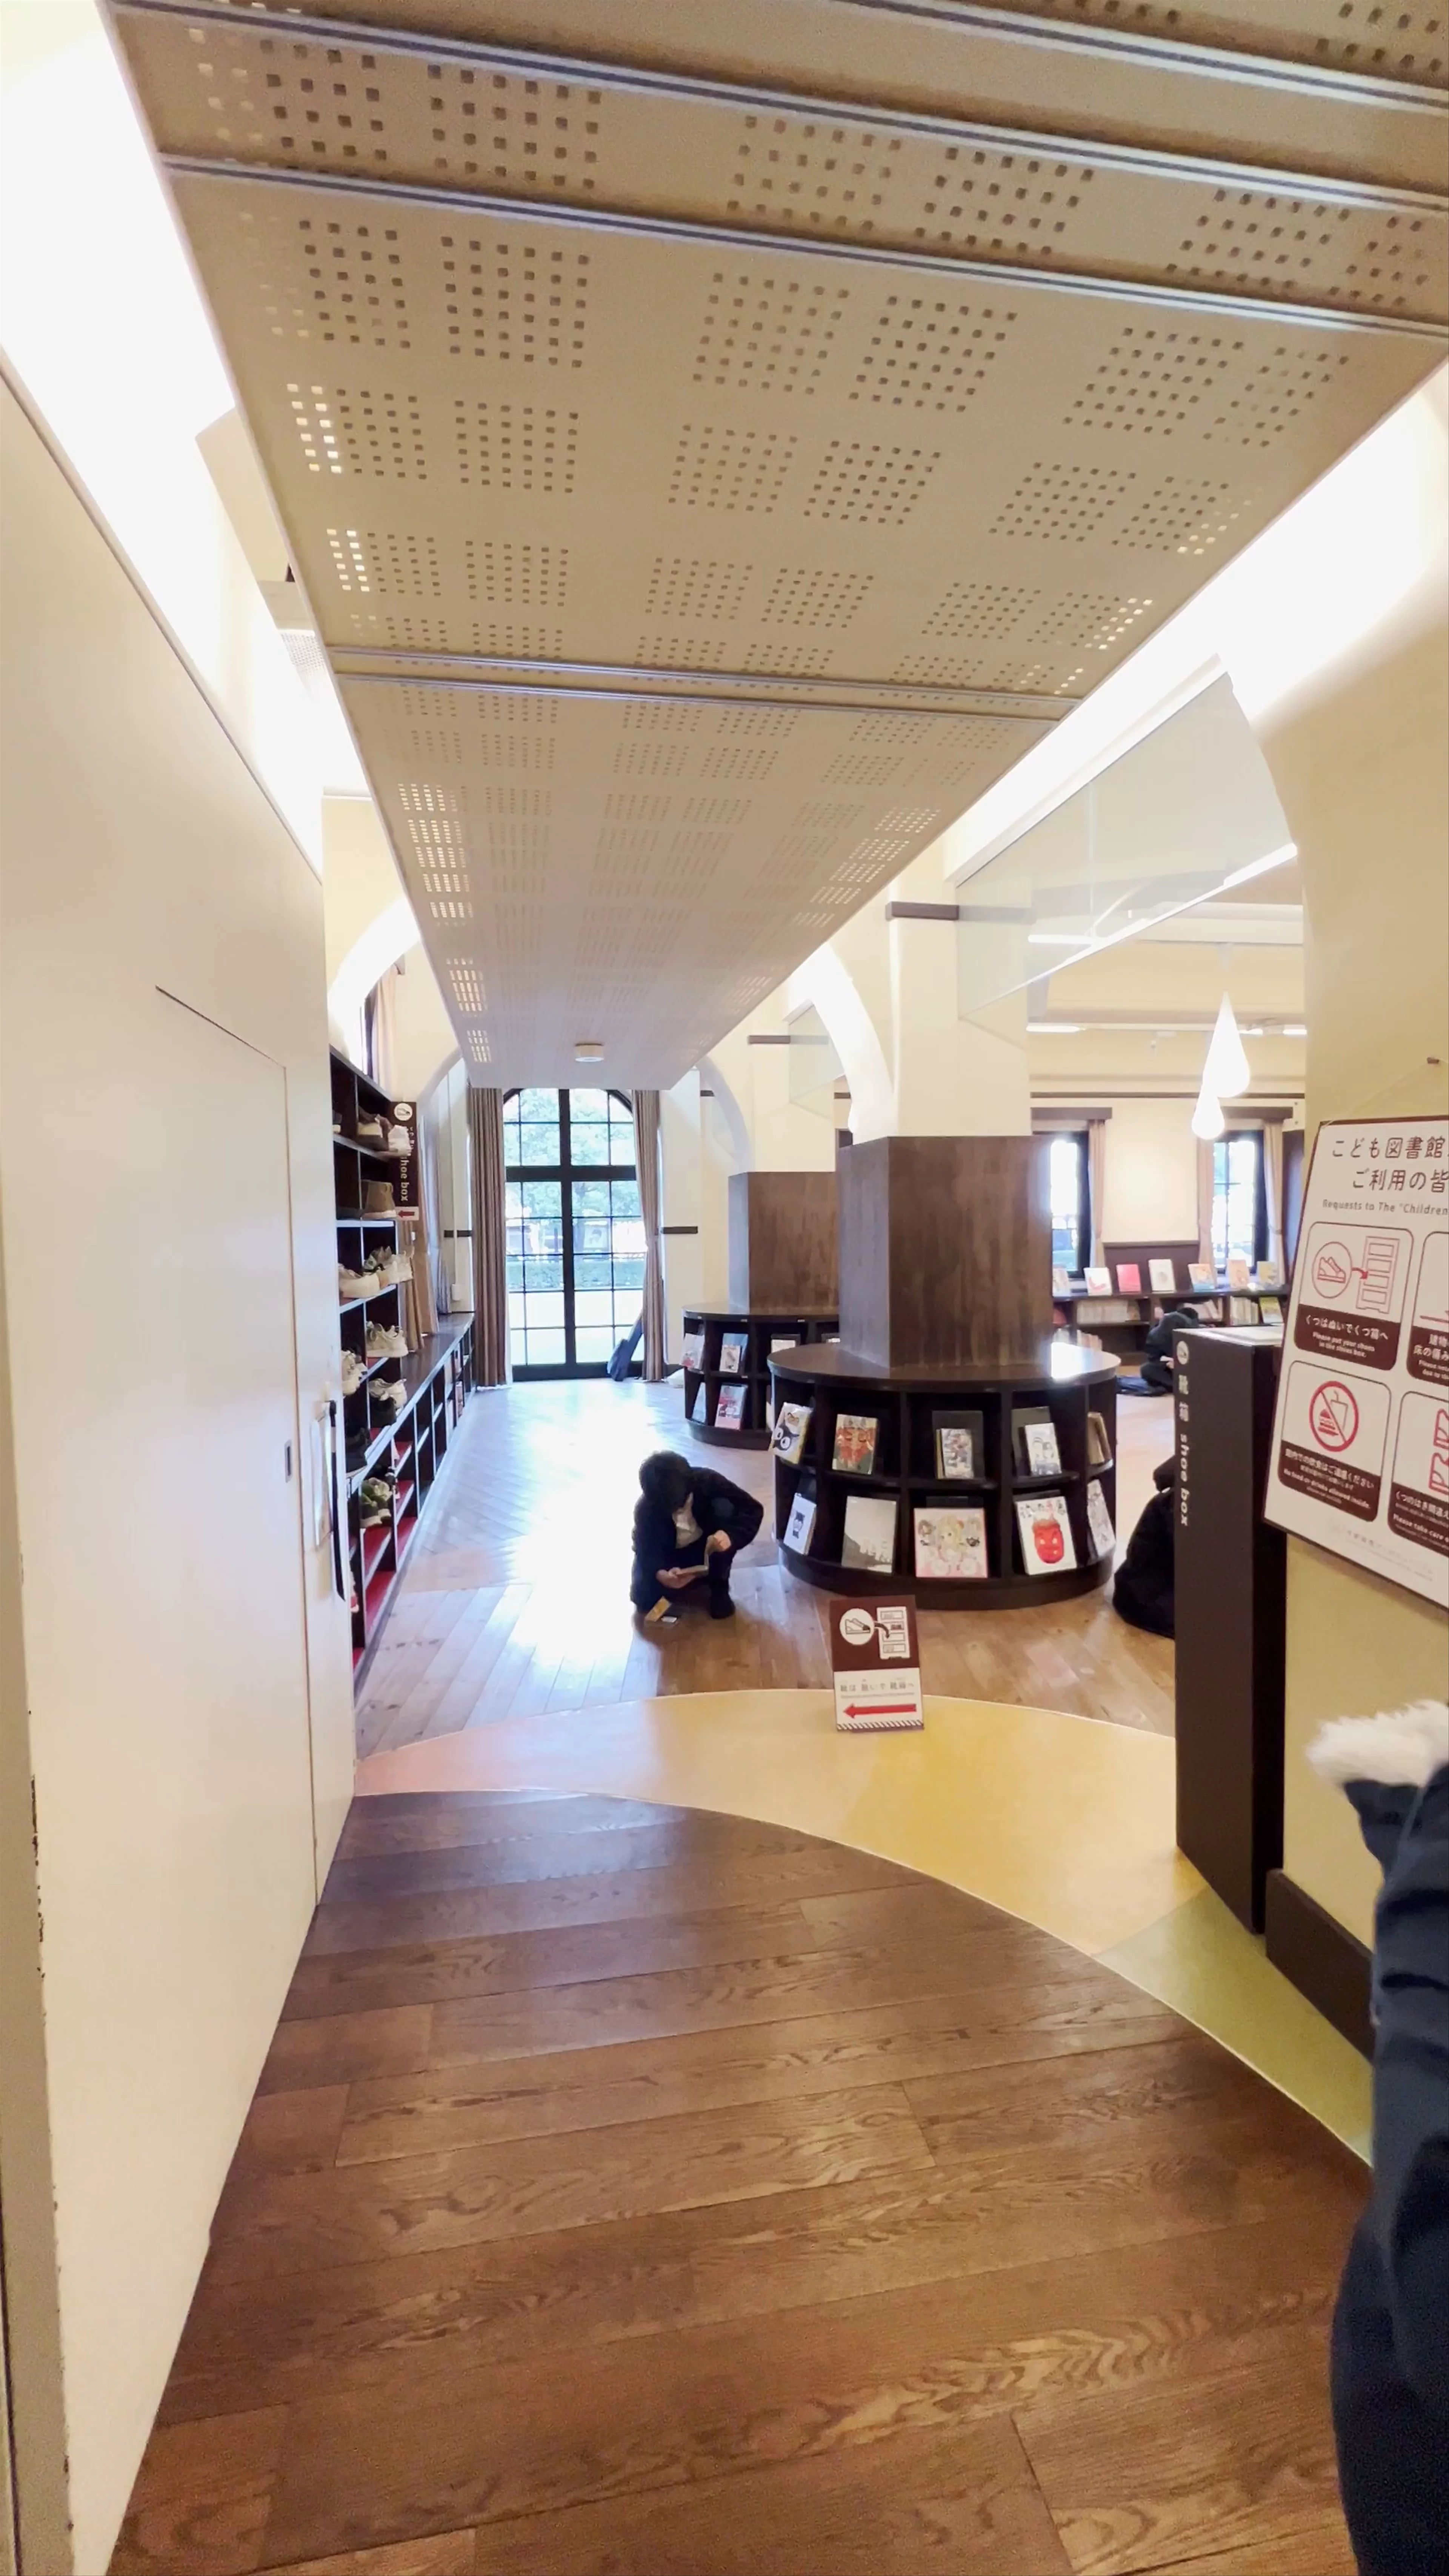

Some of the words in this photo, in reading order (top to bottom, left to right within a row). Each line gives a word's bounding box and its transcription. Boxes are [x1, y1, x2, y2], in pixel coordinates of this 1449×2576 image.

[1332, 1136, 1449, 1159] こども図書館
[400, 1155, 409, 1179] hoe
[400, 1182, 410, 1201] box
[1353, 1168, 1449, 1193] ご利用の皆
[1323, 1199, 1362, 1210] Requests
[1365, 1202, 1375, 1210] to
[1379, 1202, 1395, 1212] The
[1180, 1433, 1189, 1482] shoe
[1181, 1487, 1189, 1526] box
[1393, 1513, 1413, 1527] Please
